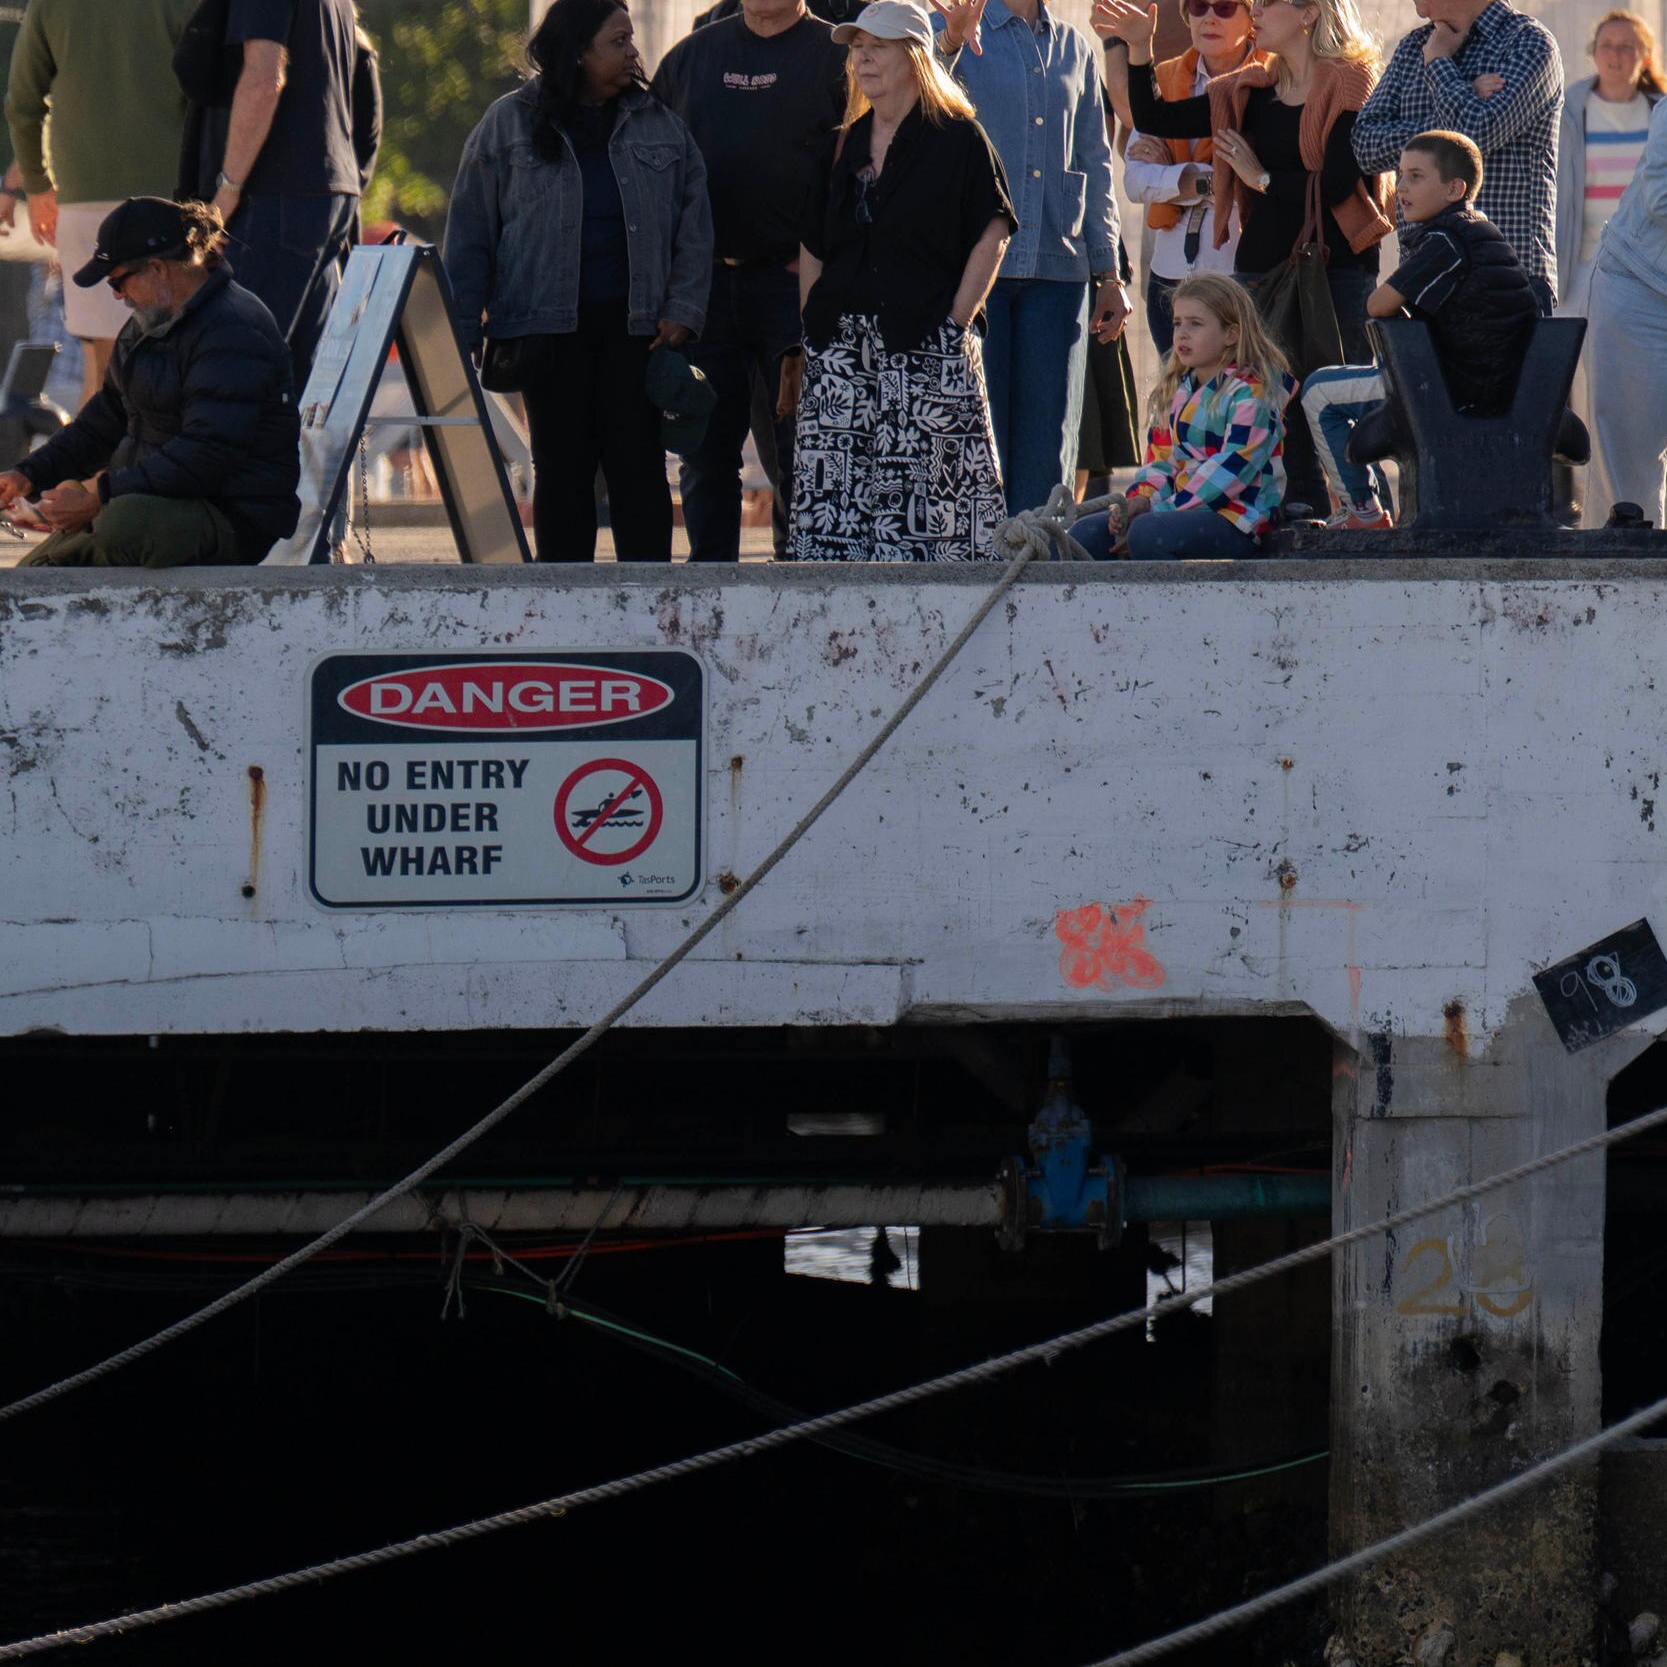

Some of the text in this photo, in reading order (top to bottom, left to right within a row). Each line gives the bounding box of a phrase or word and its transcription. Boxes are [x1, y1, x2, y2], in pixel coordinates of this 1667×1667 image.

[369, 680, 641, 714] DANGER
[337, 759, 530, 791] NO ENTRY
[366, 802, 499, 834] UNDER
[360, 844, 503, 877] WHARF
[637, 875, 676, 885] TasPorts
[1560, 951, 1638, 1026] 98
